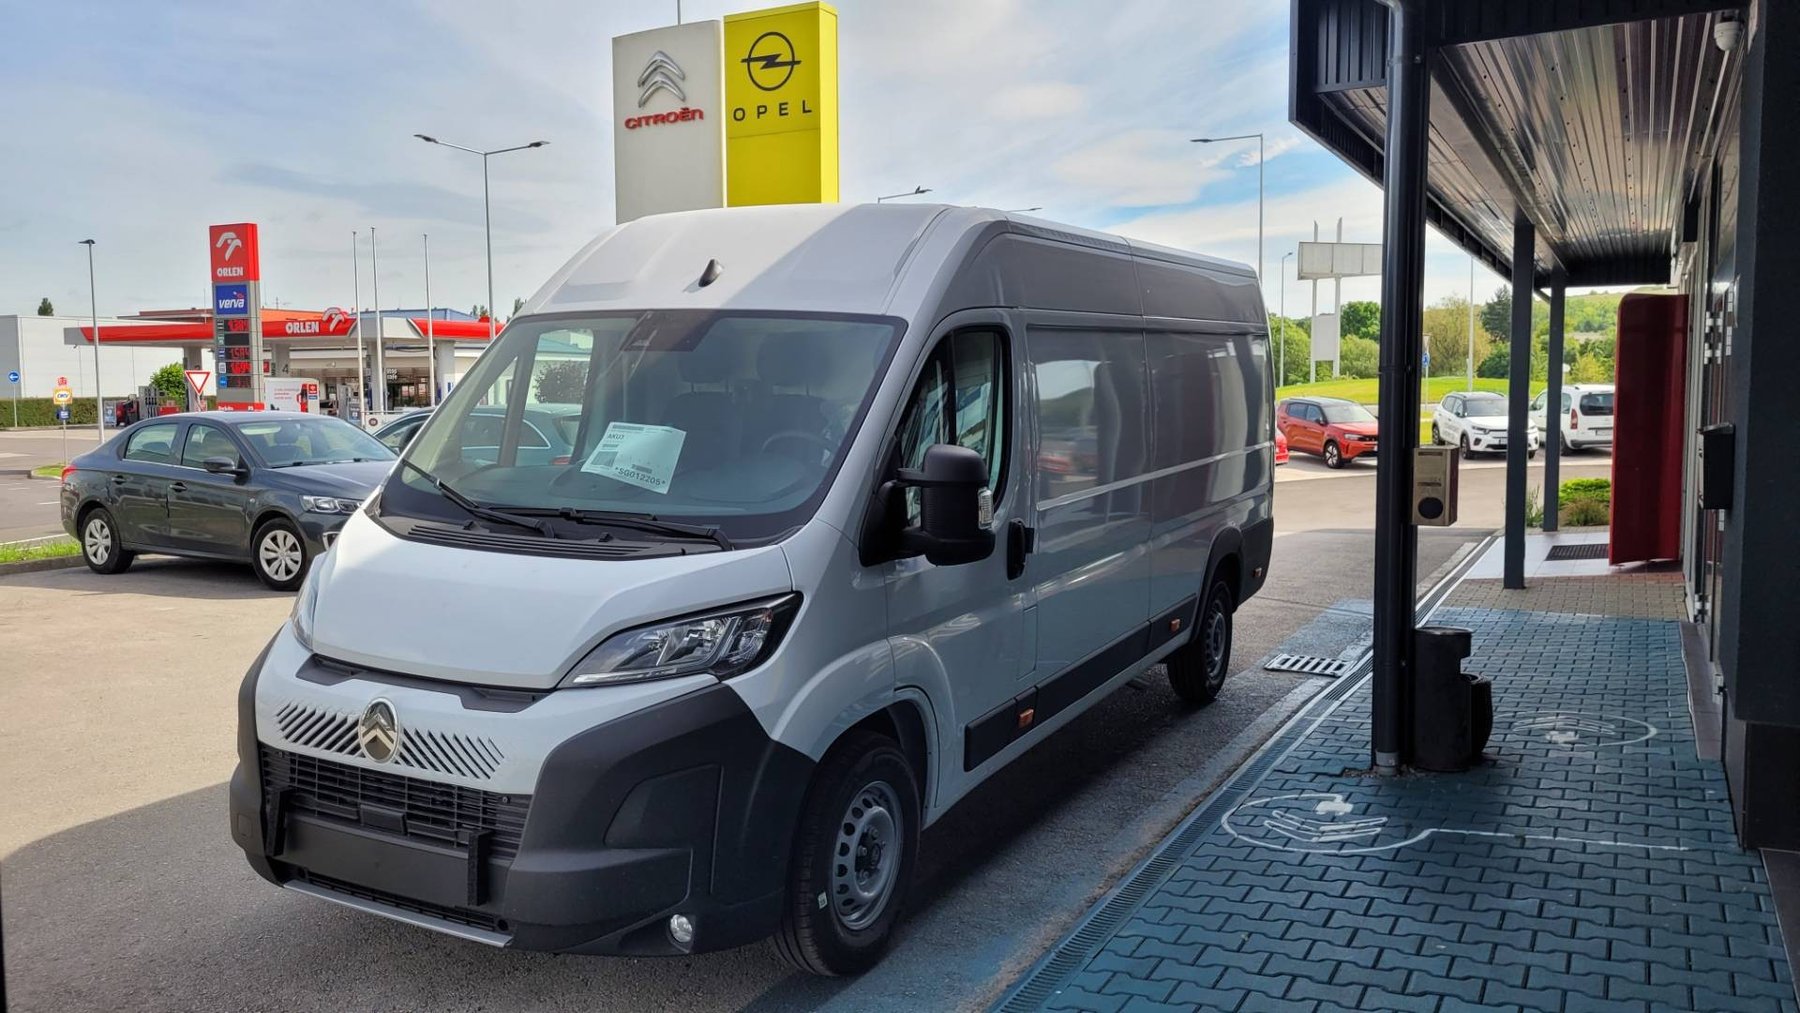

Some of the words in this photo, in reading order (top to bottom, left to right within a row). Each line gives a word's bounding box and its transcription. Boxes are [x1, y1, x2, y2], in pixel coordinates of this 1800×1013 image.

[733, 100, 812, 122] OPEL
[217, 267, 244, 277] ORLEN
[219, 299, 244, 309] verva
[285, 321, 319, 334] ORLEN
